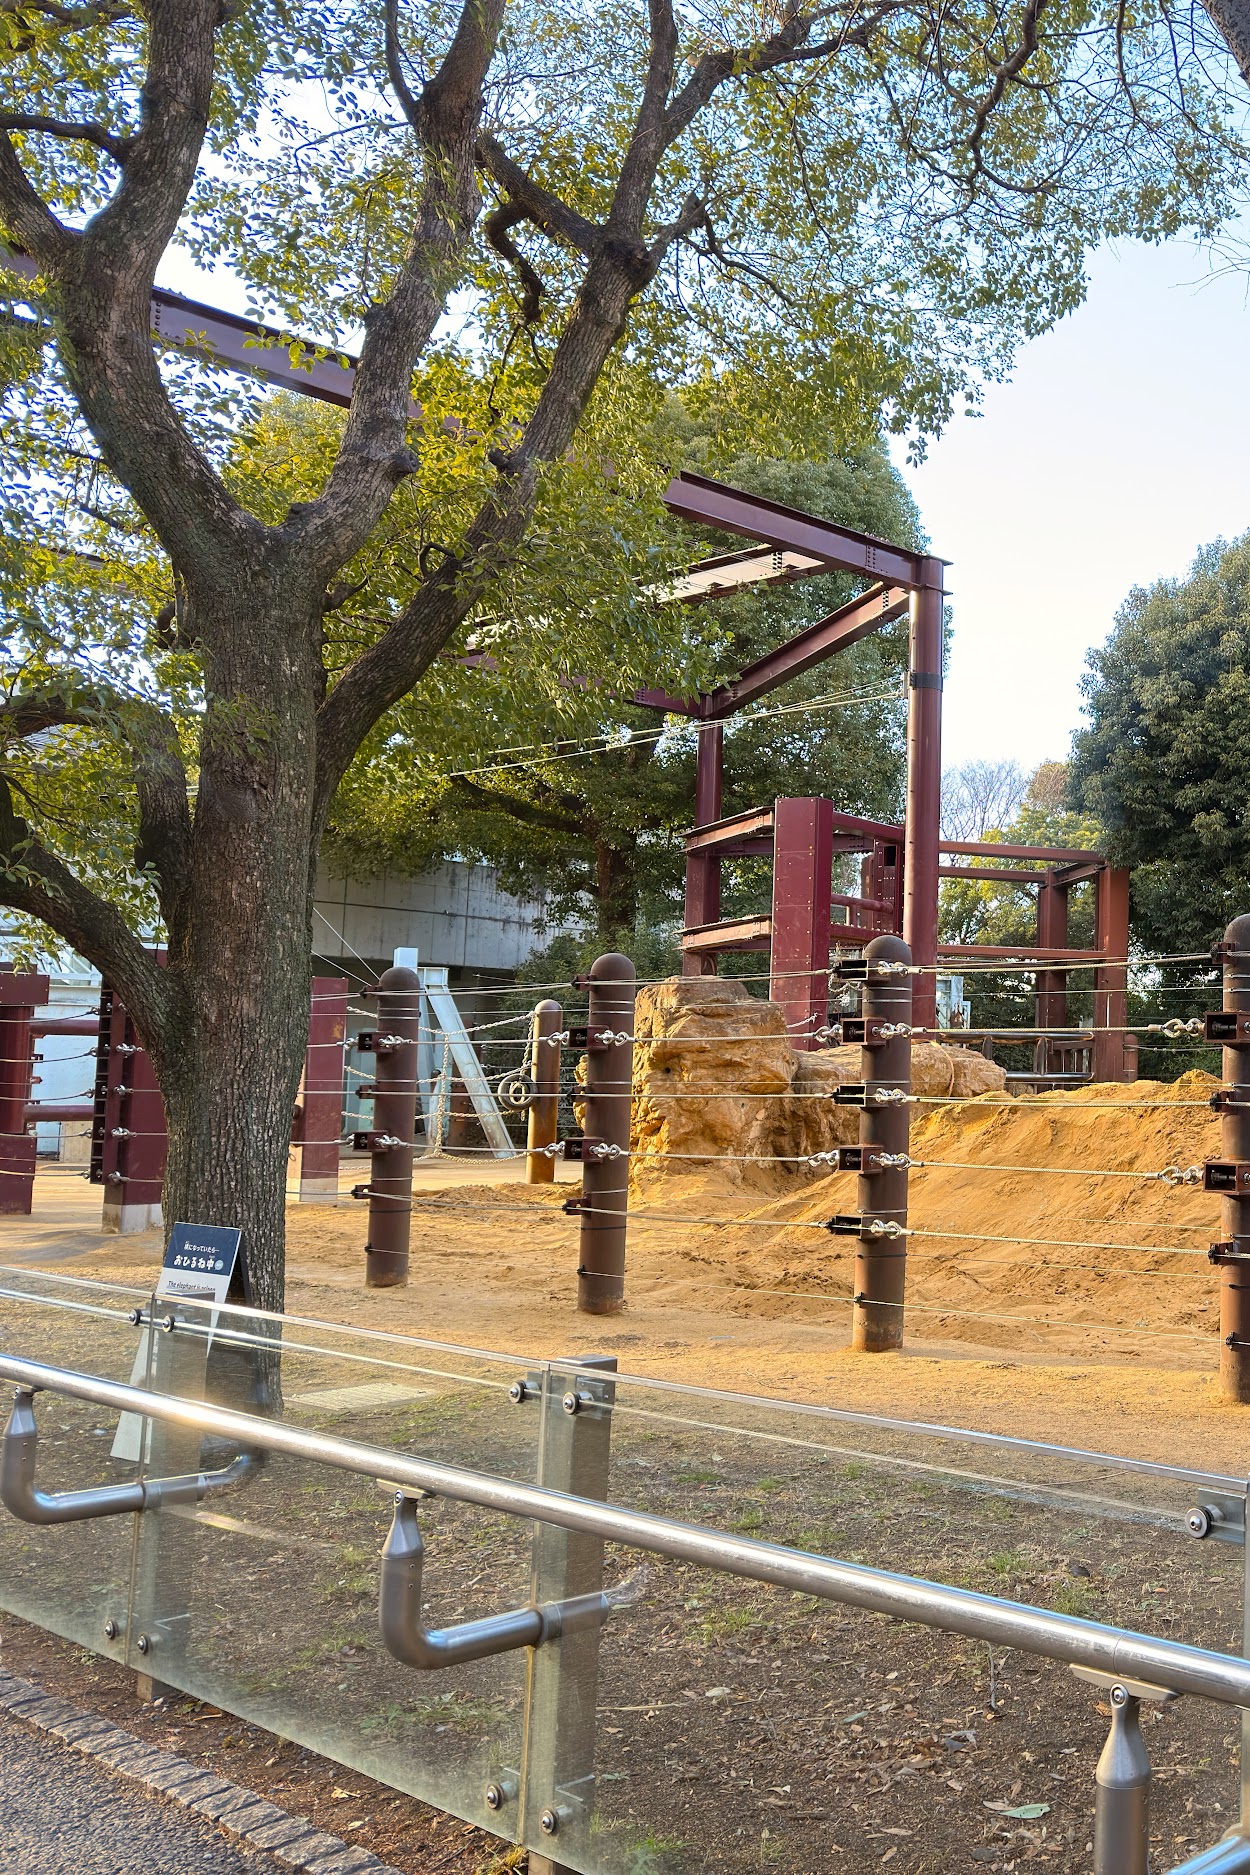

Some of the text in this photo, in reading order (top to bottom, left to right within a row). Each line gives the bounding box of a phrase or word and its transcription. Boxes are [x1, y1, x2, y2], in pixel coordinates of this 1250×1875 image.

[174, 1255, 215, 1270] おひるね中
